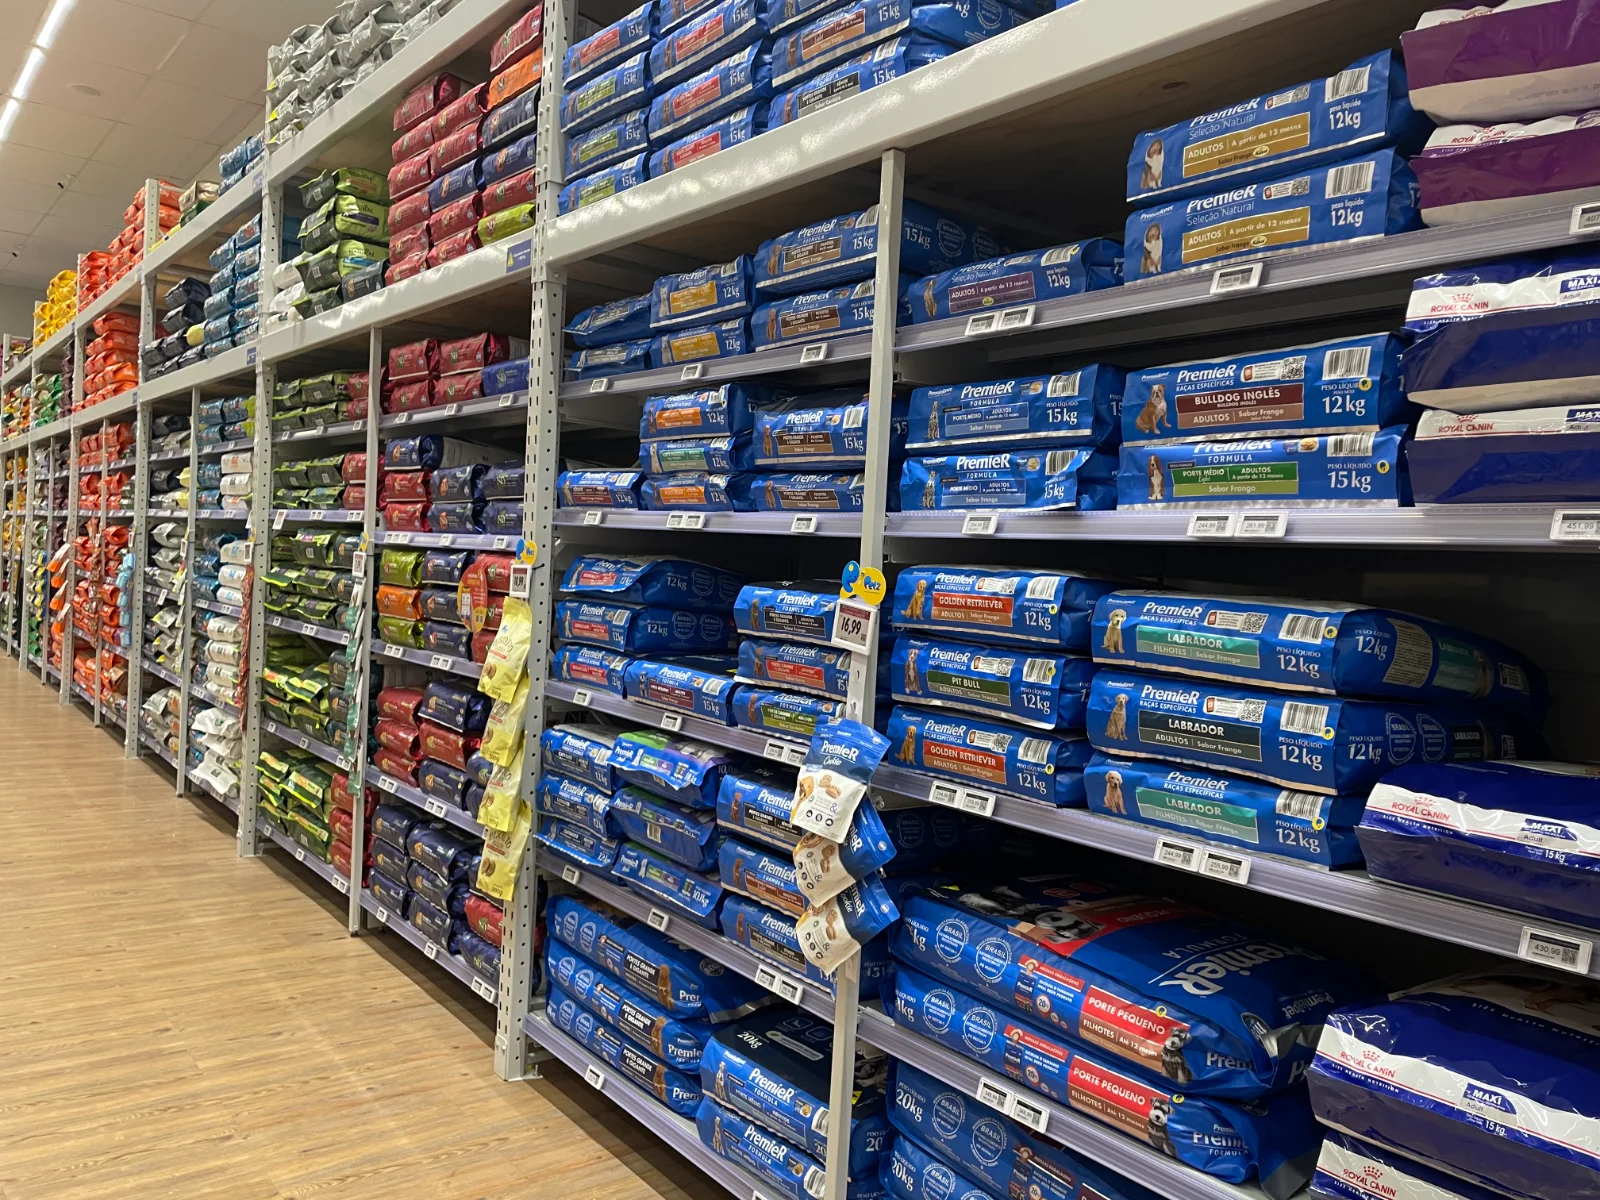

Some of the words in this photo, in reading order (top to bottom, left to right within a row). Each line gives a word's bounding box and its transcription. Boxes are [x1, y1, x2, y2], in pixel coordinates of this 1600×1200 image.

[1189, 123, 1220, 140] Seleção
[1223, 112, 1256, 128] Natural
[1188, 142, 1224, 159] ADULTOS
[1238, 133, 1257, 147] partir
[1259, 132, 1267, 140] de
[1269, 129, 1278, 138] 12
[1280, 123, 1302, 135] meses
[1186, 210, 1219, 226] Seleção
[1222, 201, 1254, 216] Natural
[1188, 230, 1222, 245] ADULTOS
[1236, 222, 1256, 236] partir
[1268, 218, 1277, 227] 12
[1279, 216, 1301, 227] meses
[1568, 277, 1596, 288] MAXI
[952, 288, 976, 298] ADULTOS
[1460, 301, 1488, 312] CANIN
[1176, 382, 1197, 392] RAÇAS
[1198, 378, 1234, 390] ESPECÍFICAS
[970, 398, 1000, 407] FORMULA
[1195, 392, 1240, 406] BULLDOG
[1244, 388, 1280, 402] INGLÊS
[1193, 413, 1230, 424] ADULTOS
[1239, 410, 1258, 418] Sabor
[1260, 408, 1284, 418] Frango
[1438, 424, 1464, 433] ROYAL
[1466, 422, 1494, 432] CANIN
[1208, 454, 1252, 464] FORMULA
[1345, 462, 1372, 470] LÍQUIDO
[1204, 468, 1224, 476] MÉDIO
[1241, 466, 1271, 474] ADULTOS
[1230, 484, 1256, 494] Frango
[940, 596, 964, 606] GOLDEN
[966, 599, 1002, 610] RETRIEVER
[941, 610, 964, 618] ADULTOS
[983, 614, 1000, 622] Frango
[1158, 616, 1197, 626] ESPECÍFICAS
[842, 616, 862, 636] 16,99
[1167, 632, 1222, 648] LABRADOR
[1154, 645, 1186, 656] FILHOTES
[1196, 652, 1215, 660] Sabor
[1217, 654, 1240, 664] Frango
[1292, 647, 1320, 658] LÍQUIDO
[952, 676, 962, 686] PIT
[964, 678, 980, 689] BULL
[1140, 700, 1158, 708] RAÇAS
[1160, 702, 1196, 714] ESPECÍFICAS
[1168, 718, 1224, 736] LABRADOR
[1156, 734, 1188, 745] ADULTOS
[1198, 740, 1216, 748] Sabor
[1218, 743, 1242, 754] Frango
[1296, 738, 1323, 750] LÍQUIDO
[930, 745, 958, 758] GOLDEN
[960, 751, 996, 767] RETRIEVER
[933, 760, 958, 770] ADULTOS
[1164, 782, 1182, 792] RAÇAS
[1184, 786, 1224, 800] ESPECÍFICAS
[1166, 798, 1222, 816] LABRADOR
[1392, 802, 1420, 816] ROYAL
[1420, 808, 1450, 822] CANIN
[1156, 810, 1187, 823] FILHOTES
[1532, 822, 1562, 834] MAXI
[1524, 834, 1542, 843] Adult
[944, 925, 964, 939] BRASIL
[984, 944, 1006, 959] BRASIL
[930, 996, 950, 1010] BRASIL
[970, 1014, 992, 1030] BRASIL
[1089, 996, 1117, 1016] PORTE
[1117, 1008, 1166, 1035] PEQUENO
[737, 1032, 763, 1050] 20kg
[1084, 1019, 1114, 1039] FILHOTES
[1130, 1039, 1138, 1048] 12
[1074, 1067, 1100, 1087] PORTE
[1101, 1080, 1146, 1106] PEQUENO
[754, 1088, 778, 1106] FORMULA
[1072, 1090, 1102, 1110] FILHOTES
[1117, 1112, 1124, 1120] 12
[1473, 1089, 1502, 1105] MAXI
[941, 1100, 961, 1116] BRASIL
[1466, 1101, 1484, 1112] Adult
[980, 1125, 1002, 1142] BRASIL
[748, 1145, 772, 1166] FORMULA
[930, 1170, 950, 1186] BRASIL
[1343, 1168, 1370, 1190] ROYAL
[1370, 1179, 1397, 1198] CANIN
